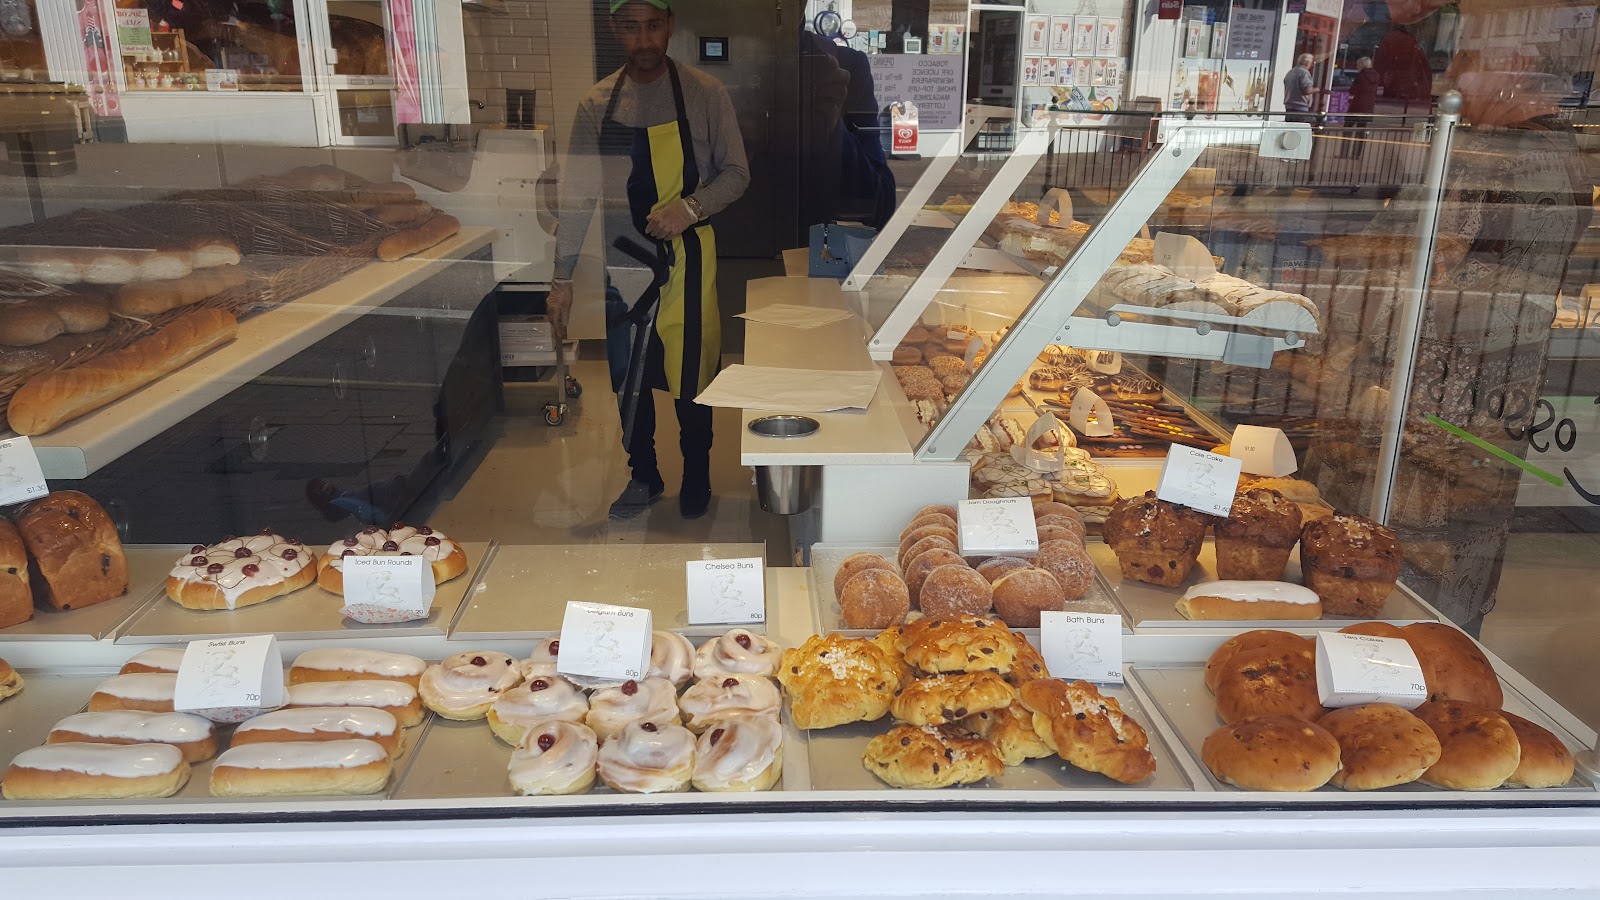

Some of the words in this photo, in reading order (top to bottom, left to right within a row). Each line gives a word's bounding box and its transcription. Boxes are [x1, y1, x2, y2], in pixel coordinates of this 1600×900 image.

[1206, 454, 1223, 463] Cake
[1086, 616, 1105, 624] Buns
[625, 669, 639, 677] 80p
[1410, 683, 1426, 691] 70p
[245, 693, 260, 702] 70p
